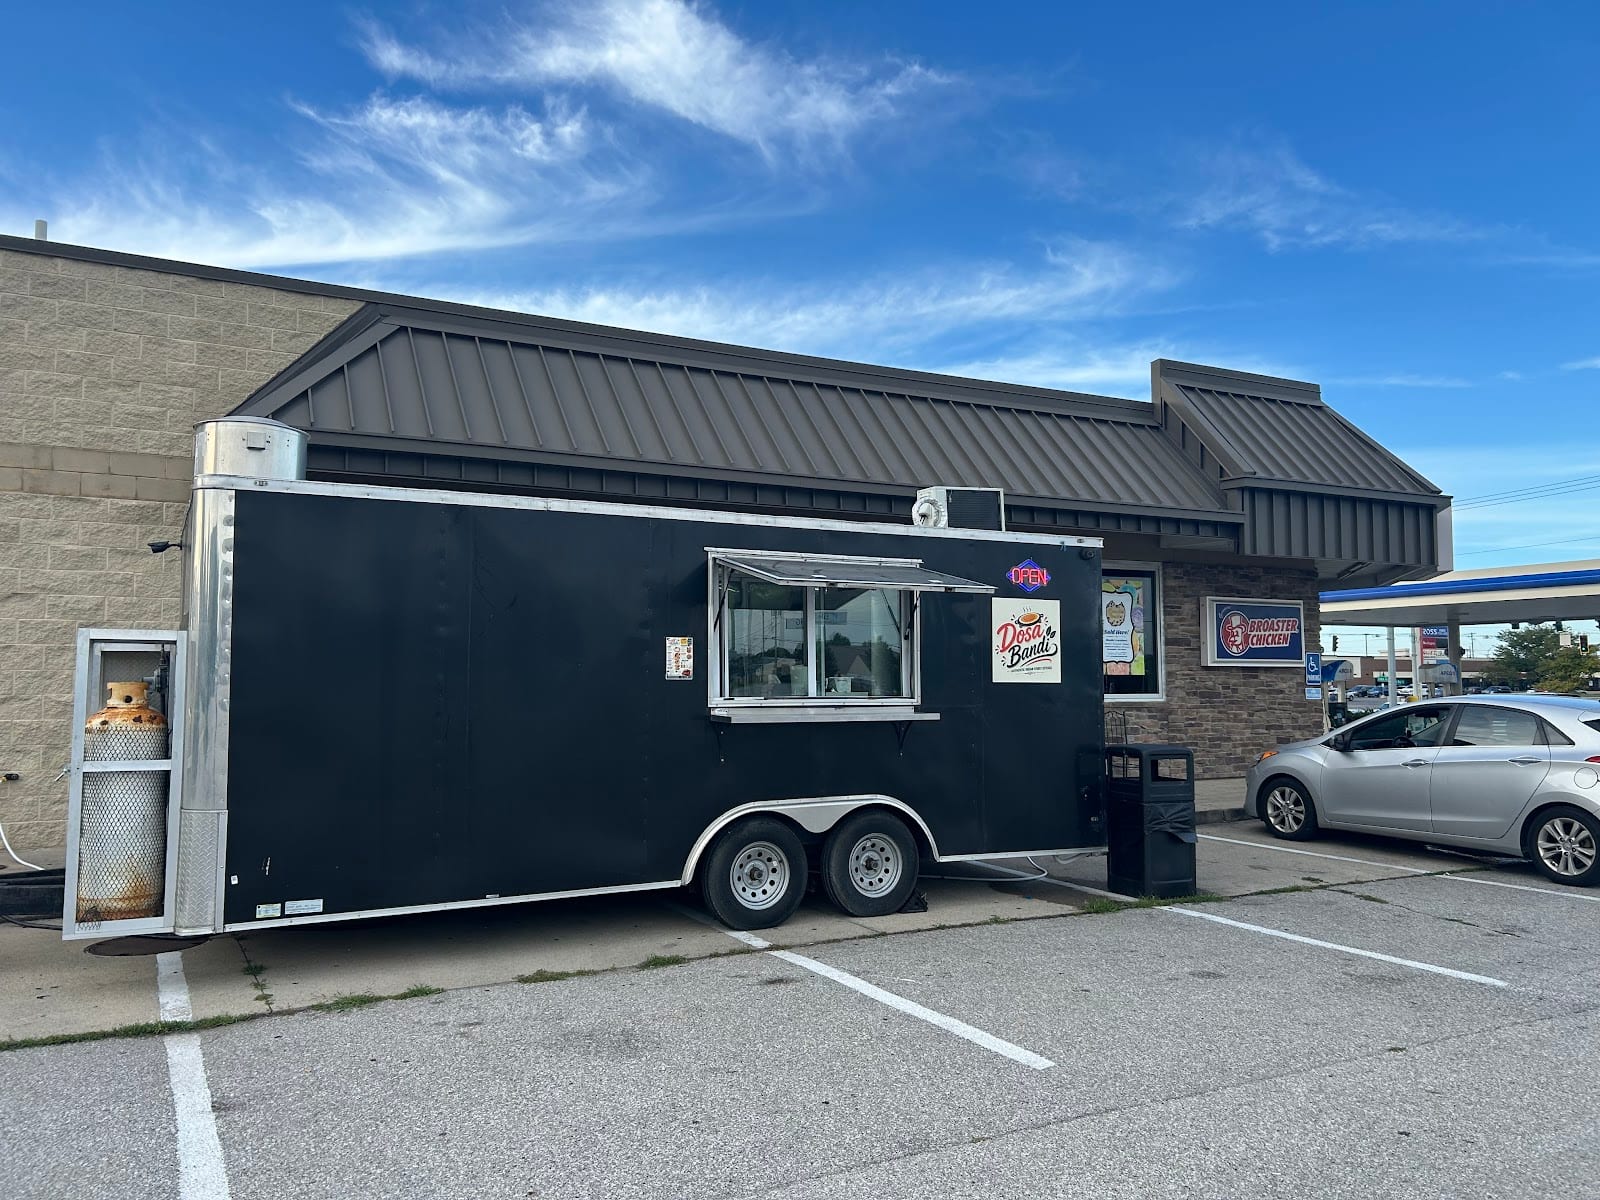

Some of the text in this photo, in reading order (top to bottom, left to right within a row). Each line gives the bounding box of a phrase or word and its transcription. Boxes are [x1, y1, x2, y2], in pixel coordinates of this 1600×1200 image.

[1011, 567, 1047, 585] OPEN
[1249, 619, 1299, 633] BROASTER
[997, 622, 1044, 653] Dosa
[1250, 632, 1290, 647] CHICKEN
[1007, 637, 1057, 669] Bandi
